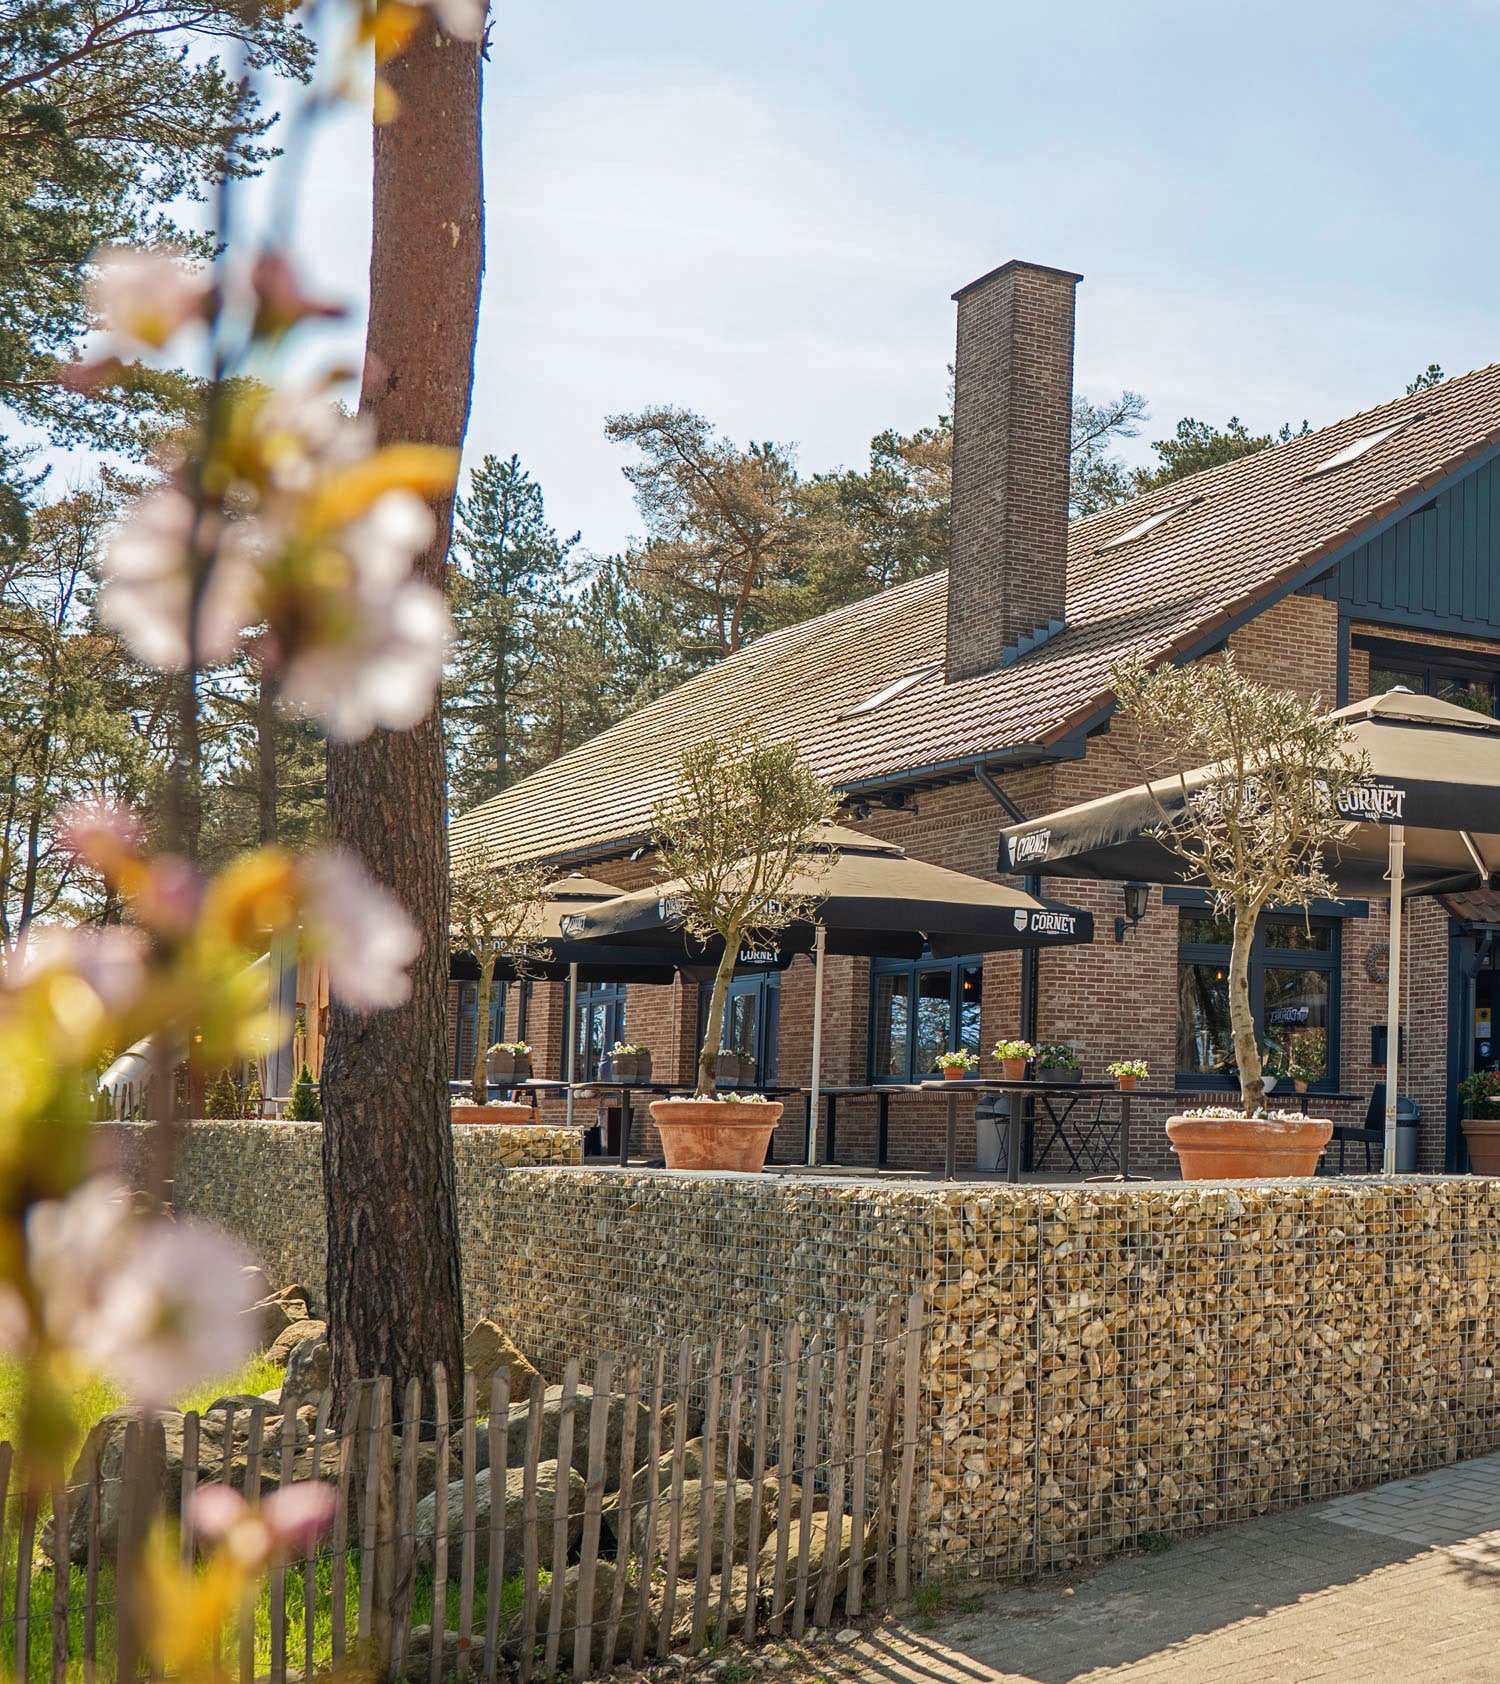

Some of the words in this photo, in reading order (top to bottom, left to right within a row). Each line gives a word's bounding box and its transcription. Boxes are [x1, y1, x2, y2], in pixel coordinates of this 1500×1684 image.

[1337, 786, 1406, 818] CORNET
[1016, 830, 1051, 862] CORNET
[1031, 913, 1076, 934] CORNET
